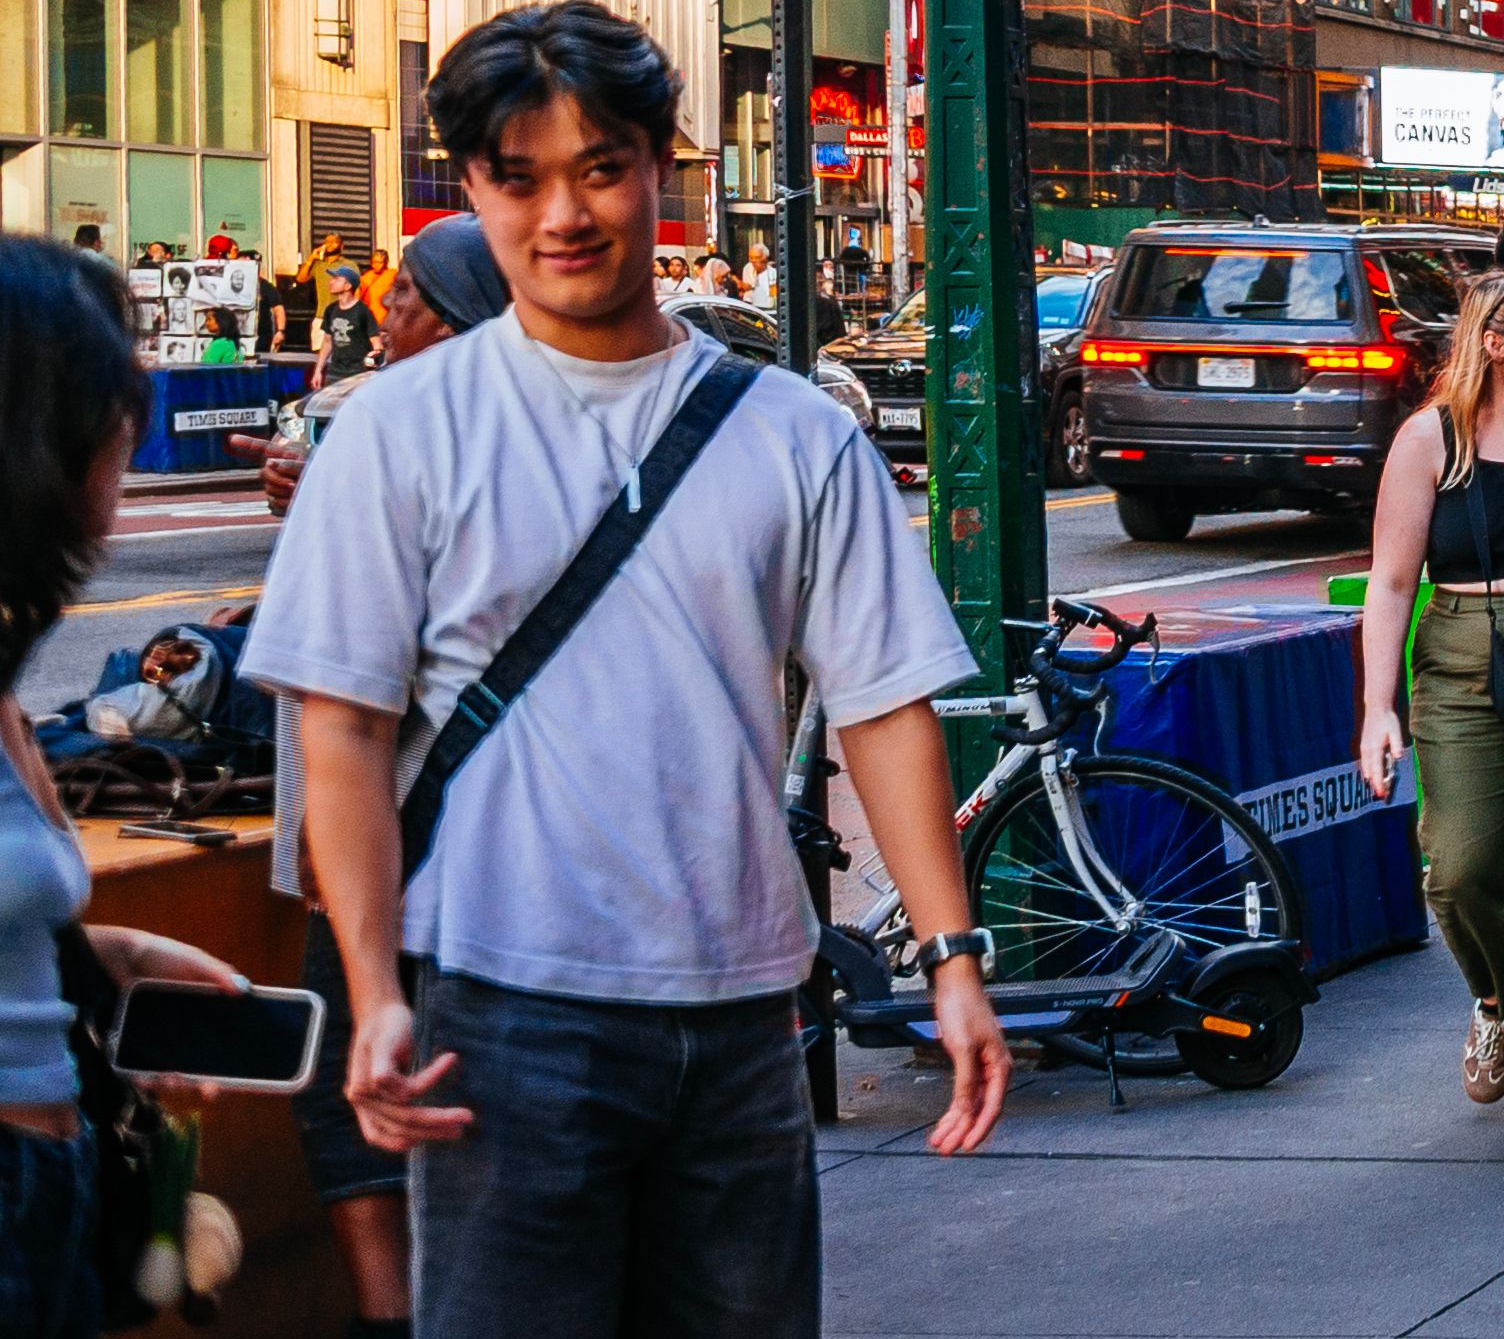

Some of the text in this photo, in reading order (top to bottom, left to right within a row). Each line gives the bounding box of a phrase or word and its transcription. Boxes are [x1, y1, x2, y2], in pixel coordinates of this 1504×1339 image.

[1393, 122, 1473, 147] CANVAS
[187, 411, 258, 428] TIMES SQUARE
